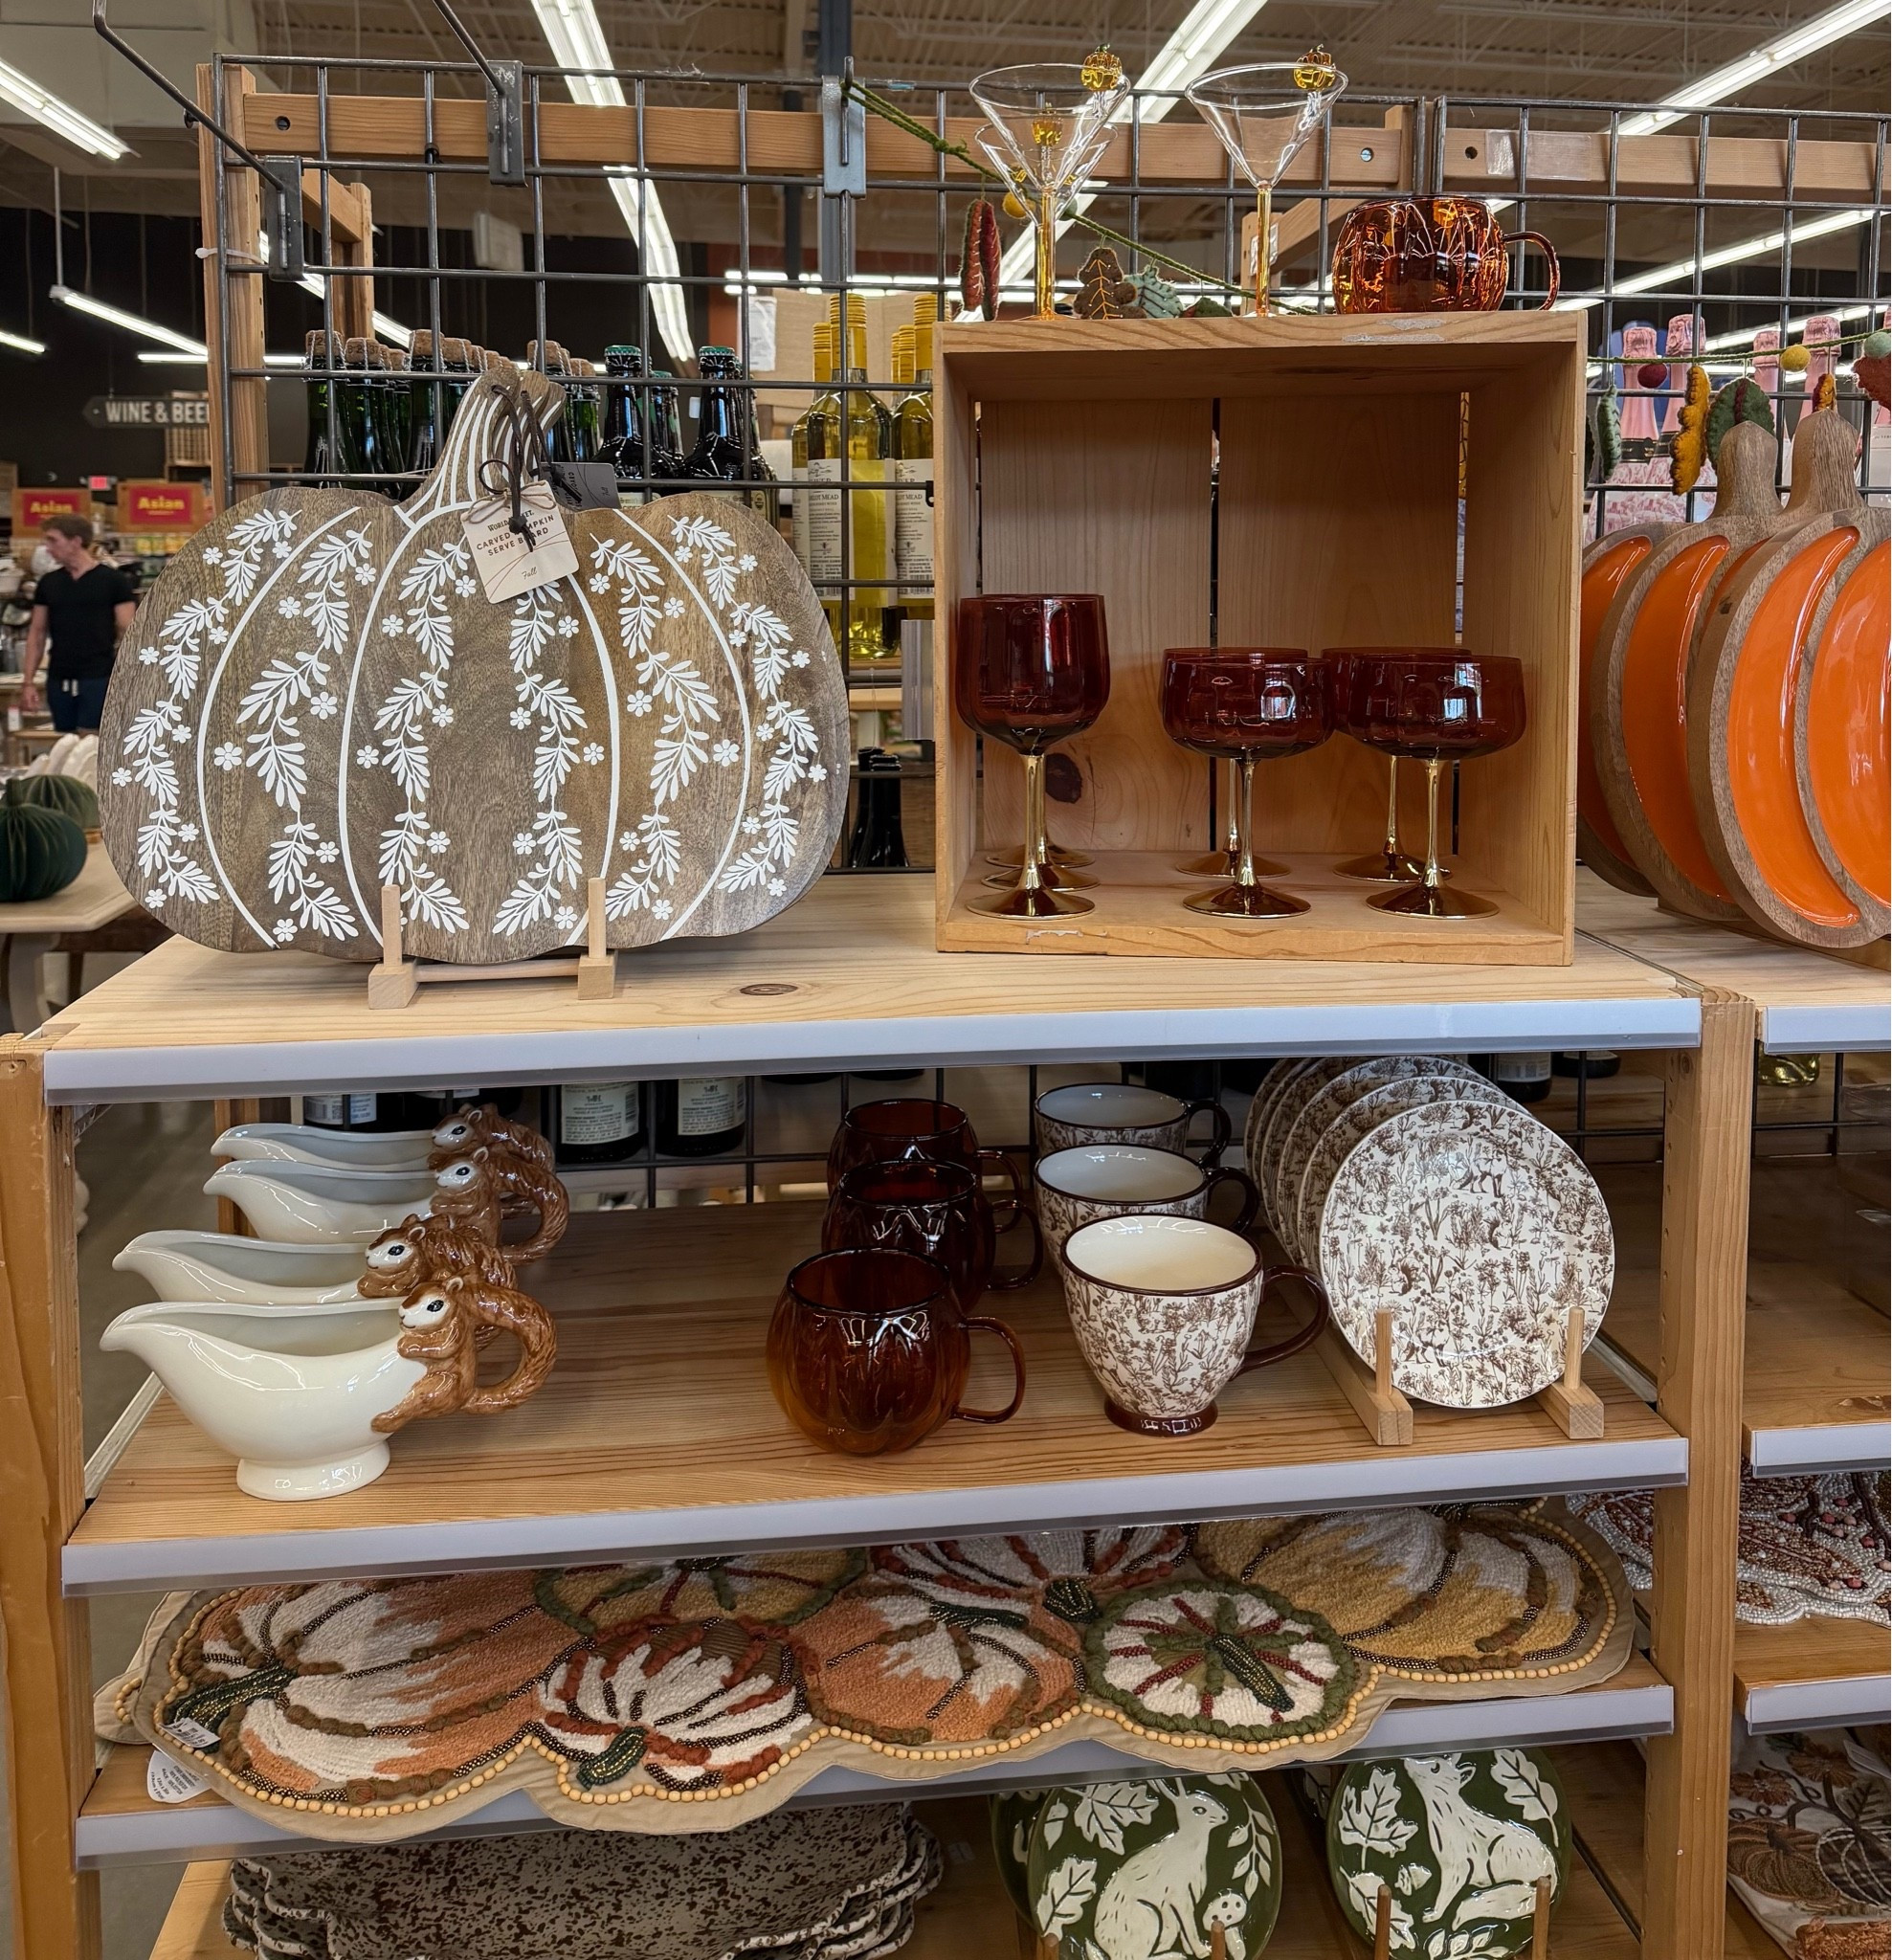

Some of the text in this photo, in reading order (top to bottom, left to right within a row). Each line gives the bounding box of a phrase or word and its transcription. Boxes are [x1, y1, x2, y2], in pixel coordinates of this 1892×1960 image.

[105, 401, 151, 423] WINE
[154, 400, 169, 424] &
[31, 501, 72, 514] Asian
[138, 496, 185, 510] Asian
[477, 532, 511, 550] CARVED
[488, 527, 549, 556] SERVE BARD
[522, 566, 537, 580] Fall
